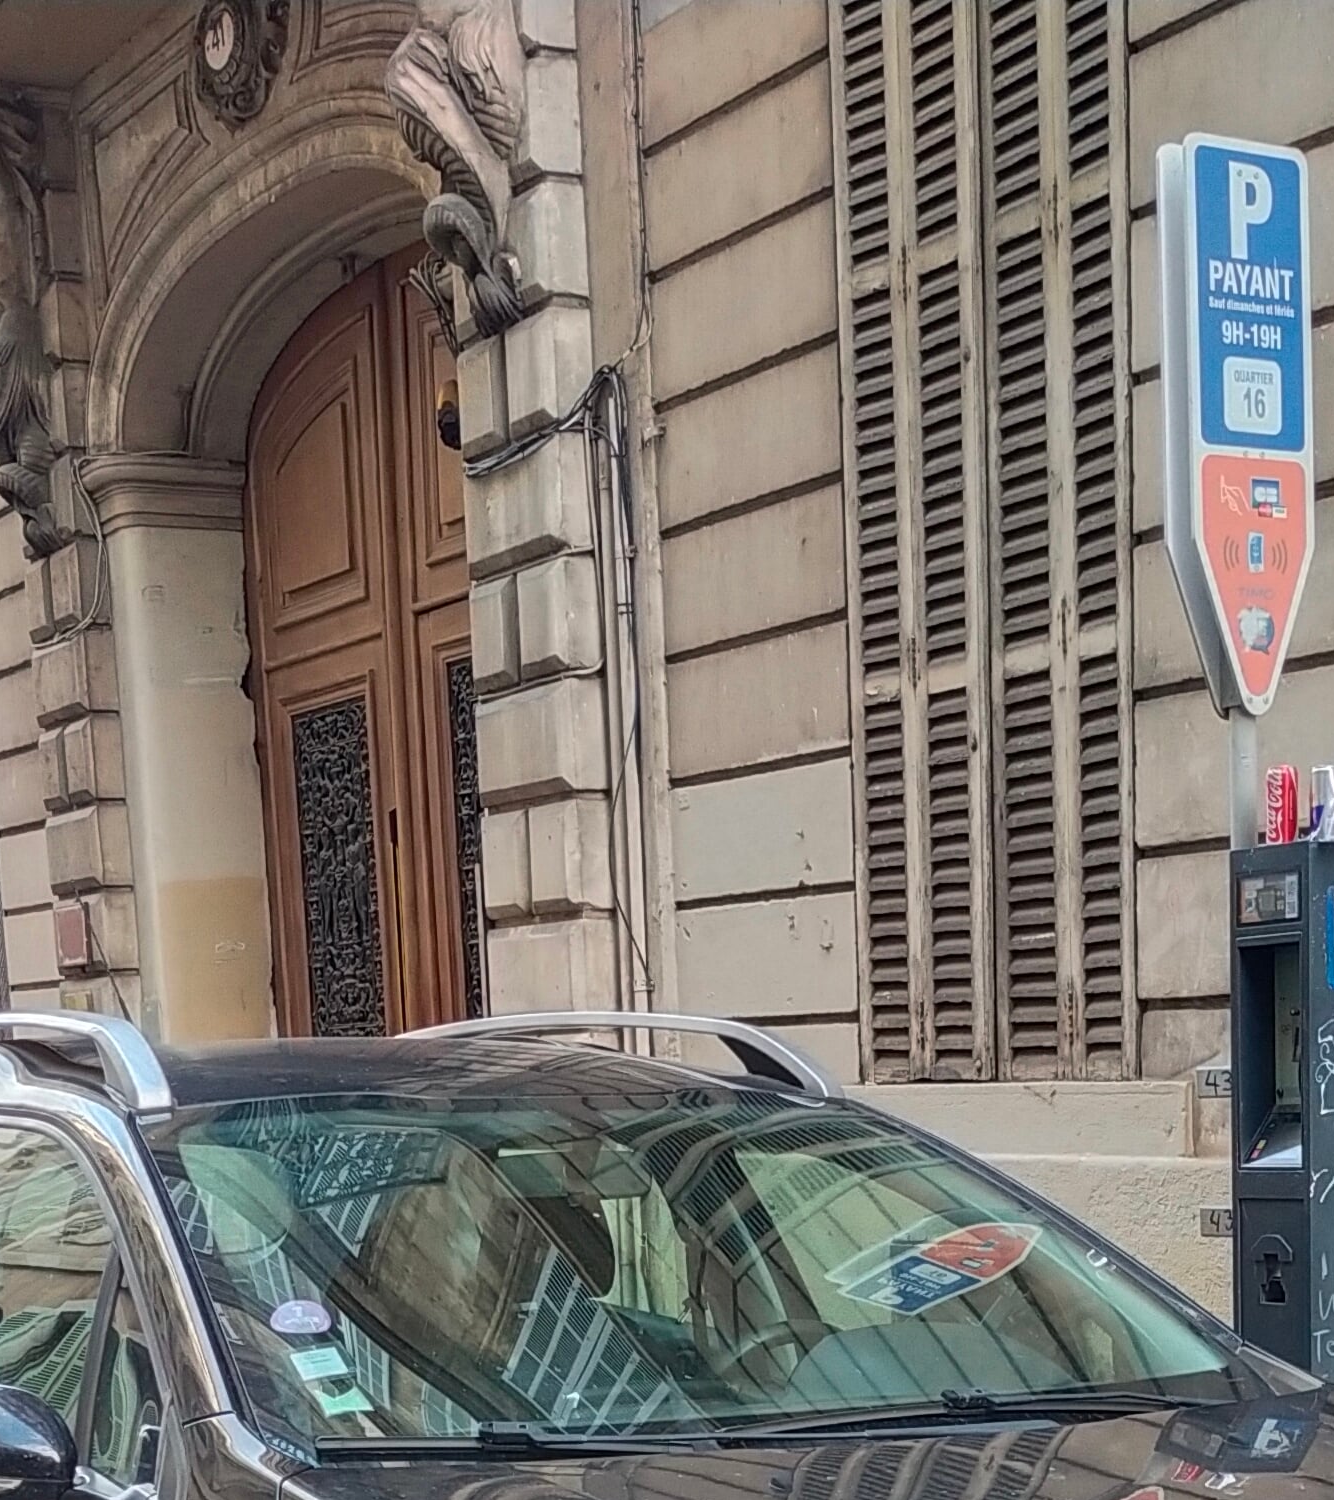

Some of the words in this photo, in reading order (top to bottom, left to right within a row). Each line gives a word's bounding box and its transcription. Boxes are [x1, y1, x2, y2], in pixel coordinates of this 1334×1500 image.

[1228, 160, 1273, 260] P
[1208, 258, 1295, 302] PAYANT
[1226, 298, 1265, 315] dimanches
[1221, 319, 1282, 350] 9H-19H
[1233, 369, 1274, 386] QUARTIER
[1242, 386, 1266, 419] 16
[1204, 1069, 1233, 1095] 43
